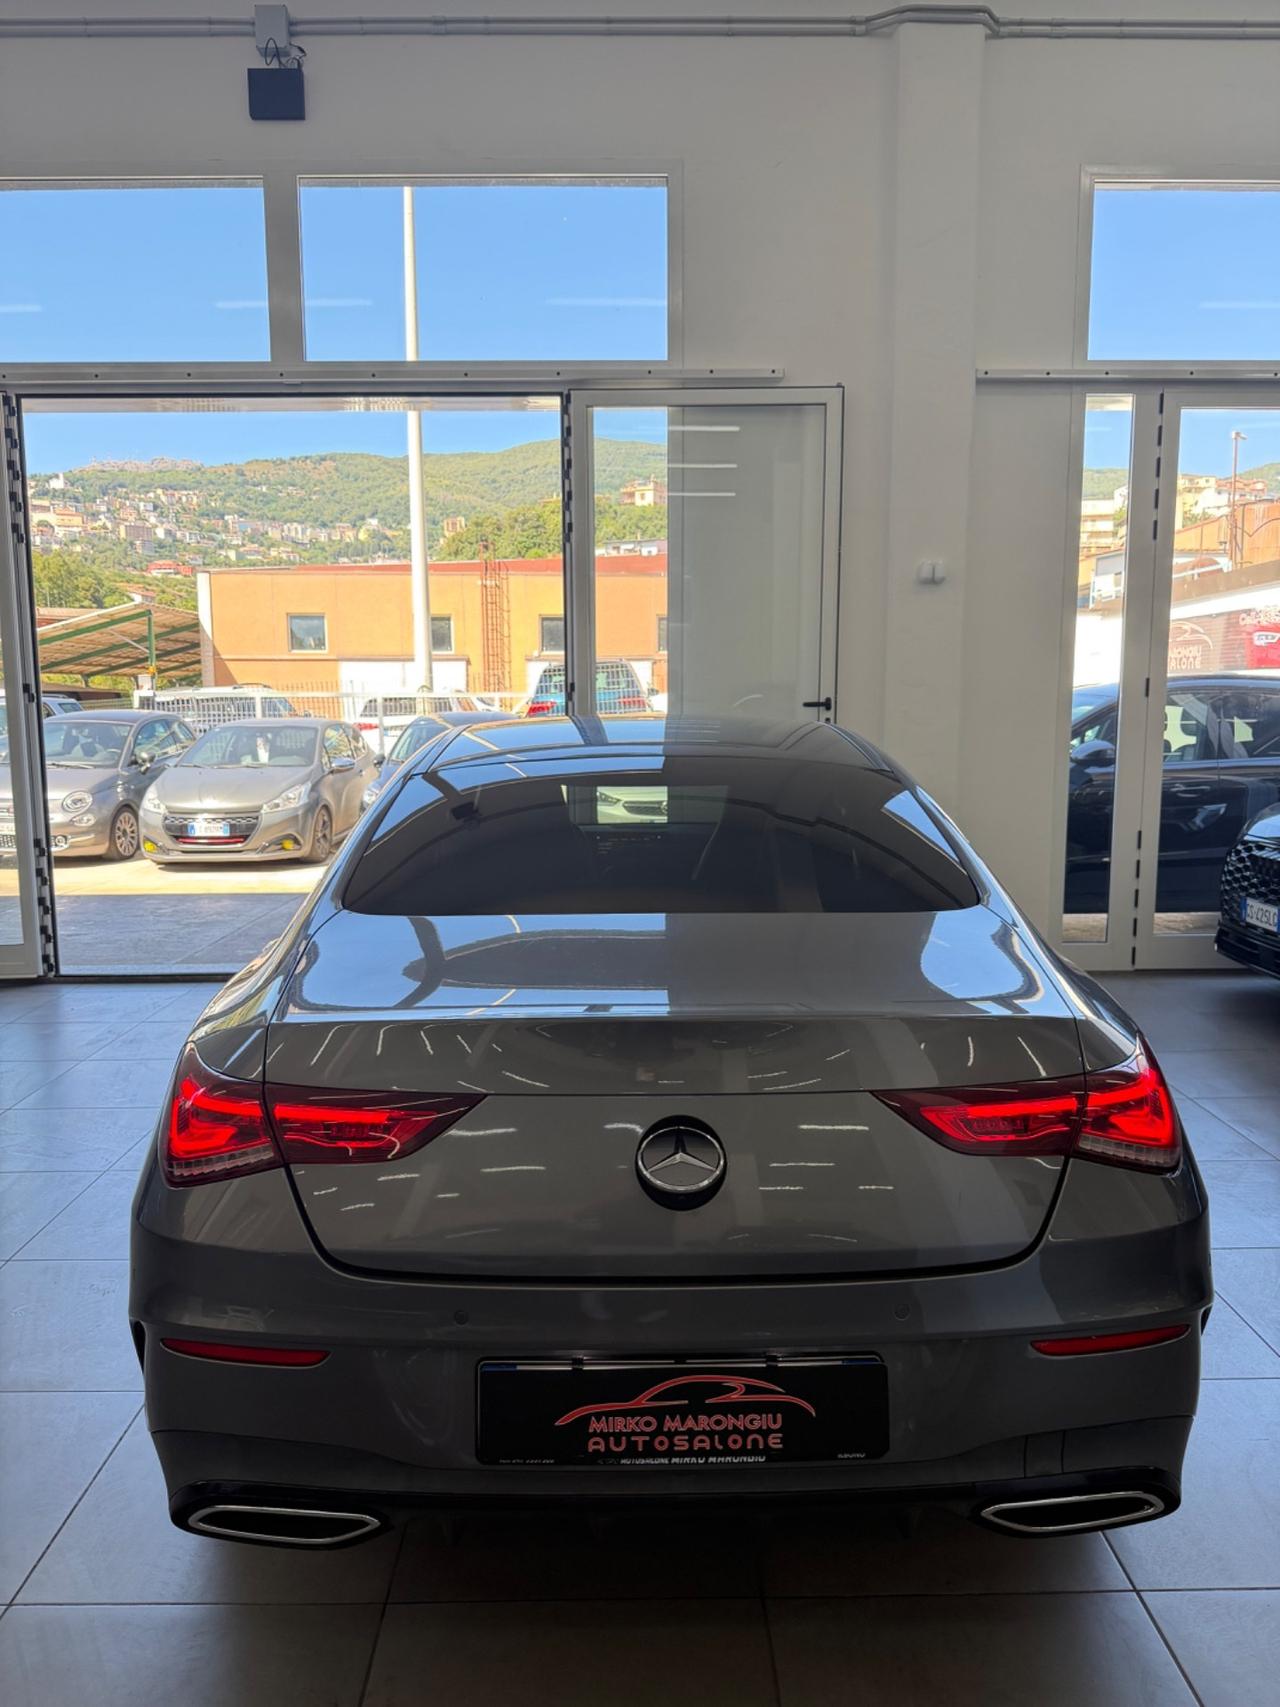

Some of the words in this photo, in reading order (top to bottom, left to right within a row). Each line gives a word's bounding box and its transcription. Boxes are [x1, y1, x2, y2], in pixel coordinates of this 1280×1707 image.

[588, 1415, 658, 1433] MIRKO
[662, 1413, 783, 1431] MARONGIU
[587, 1433, 784, 1452] AUTOSALONE
